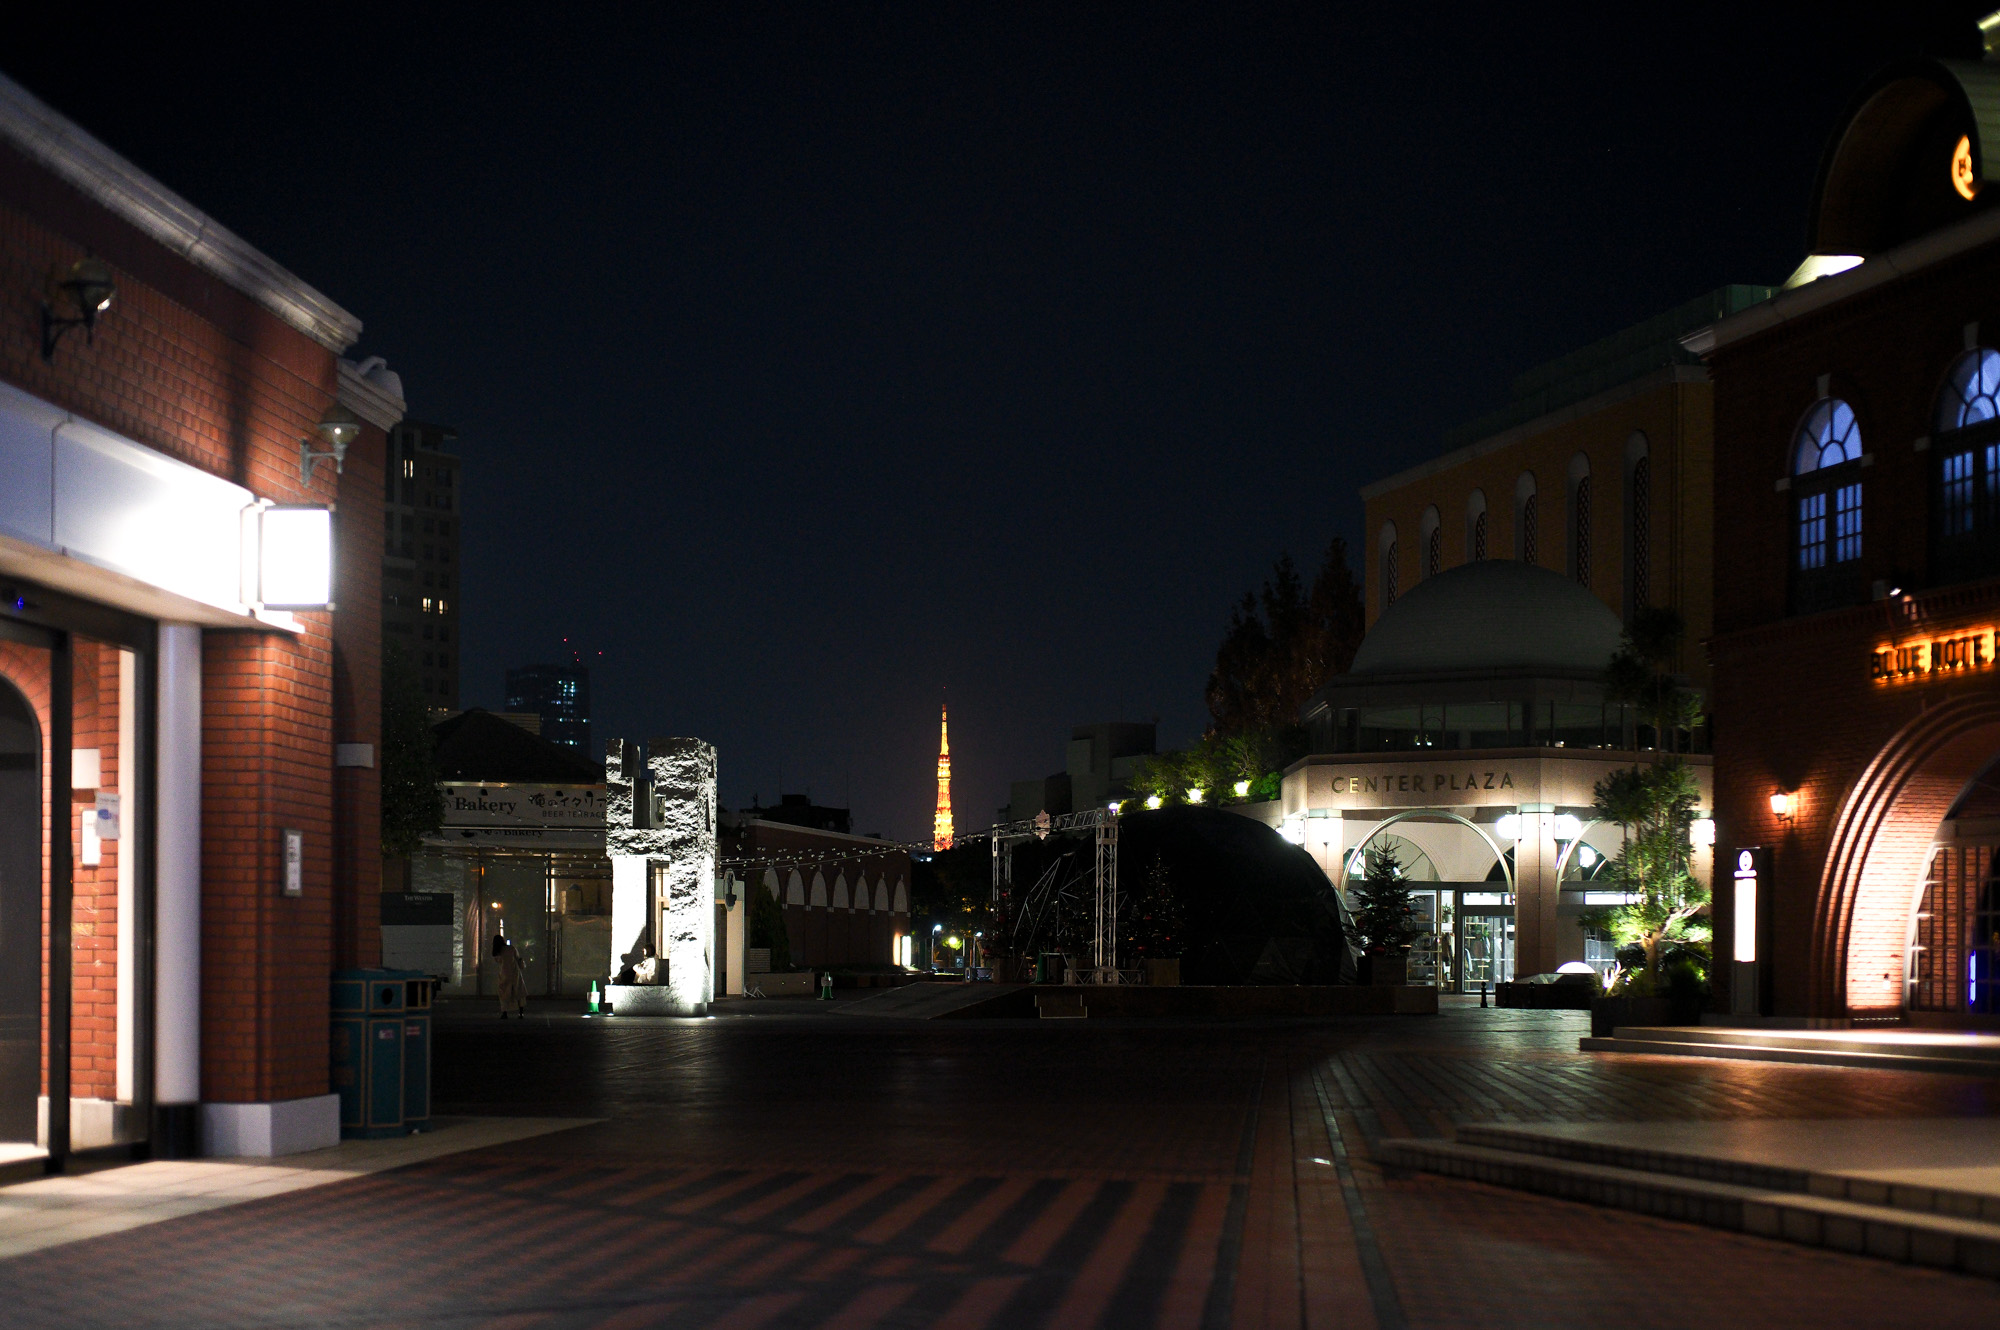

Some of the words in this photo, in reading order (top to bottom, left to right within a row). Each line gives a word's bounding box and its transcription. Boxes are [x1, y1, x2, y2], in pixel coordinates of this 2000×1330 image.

[1871, 643, 1926, 678] BLUE
[1931, 632, 1988, 671] NOTE
[1331, 774, 1426, 794] CENTER
[1434, 771, 1515, 791] PLAZA
[454, 796, 517, 815] Bakery
[542, 810, 564, 818] BEER
